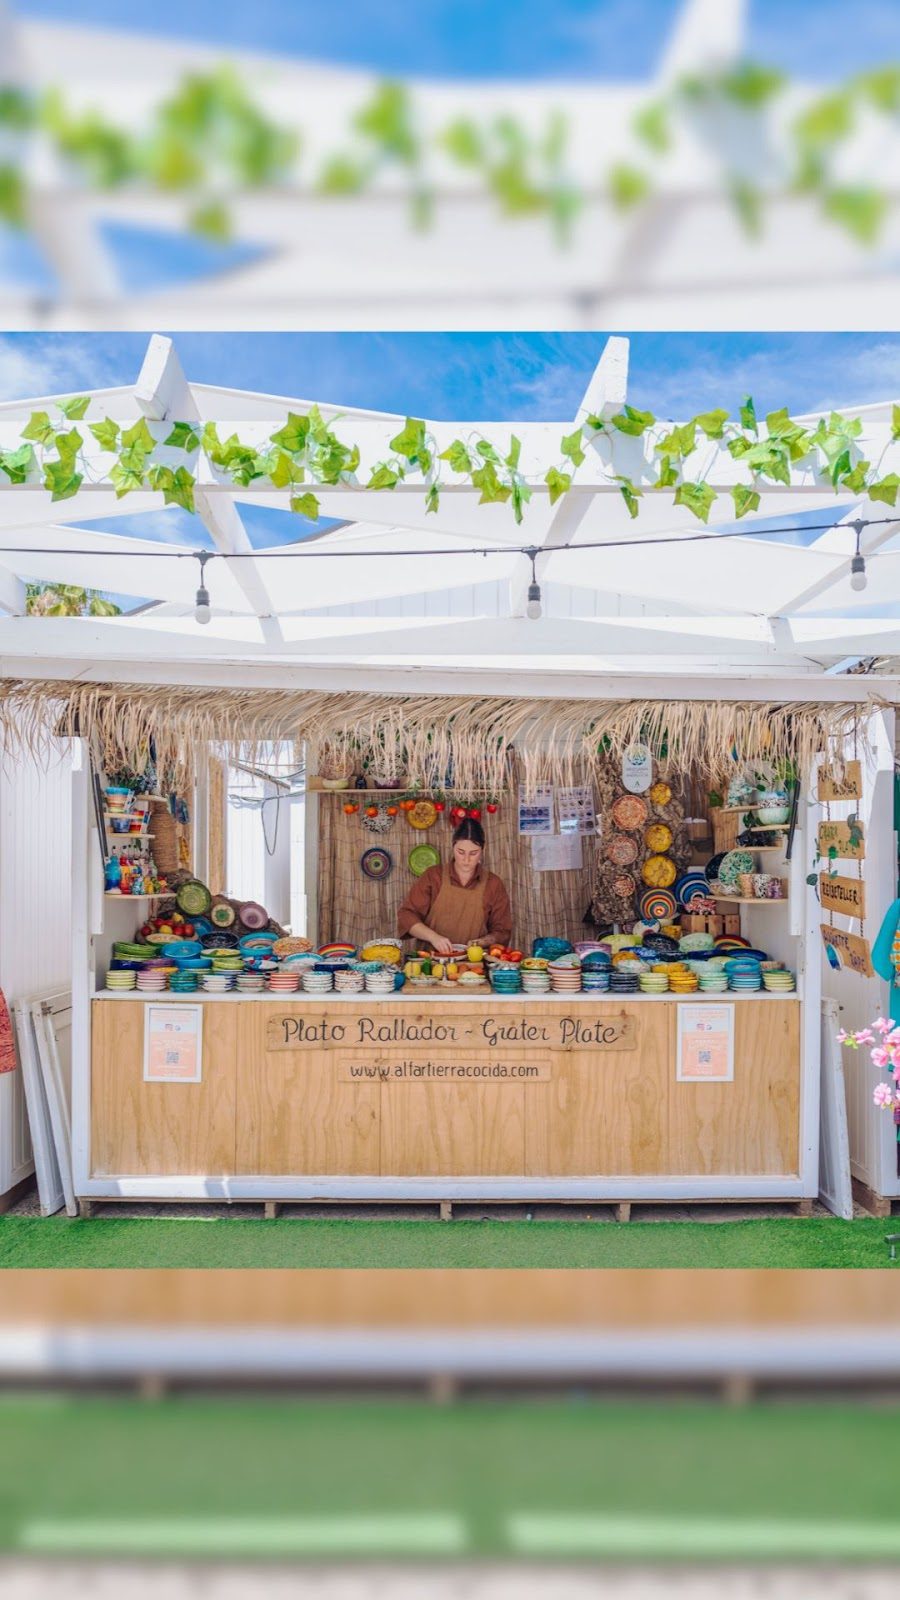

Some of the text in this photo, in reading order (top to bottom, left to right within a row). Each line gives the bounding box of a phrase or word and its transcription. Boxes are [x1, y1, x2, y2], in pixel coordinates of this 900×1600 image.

[282, 1018, 345, 1042] Plato
[354, 1017, 457, 1043] Rallador
[480, 1018, 549, 1046] Grater
[560, 1018, 619, 1044] Plate
[350, 1061, 539, 1079] www.alfartierracocida.com
